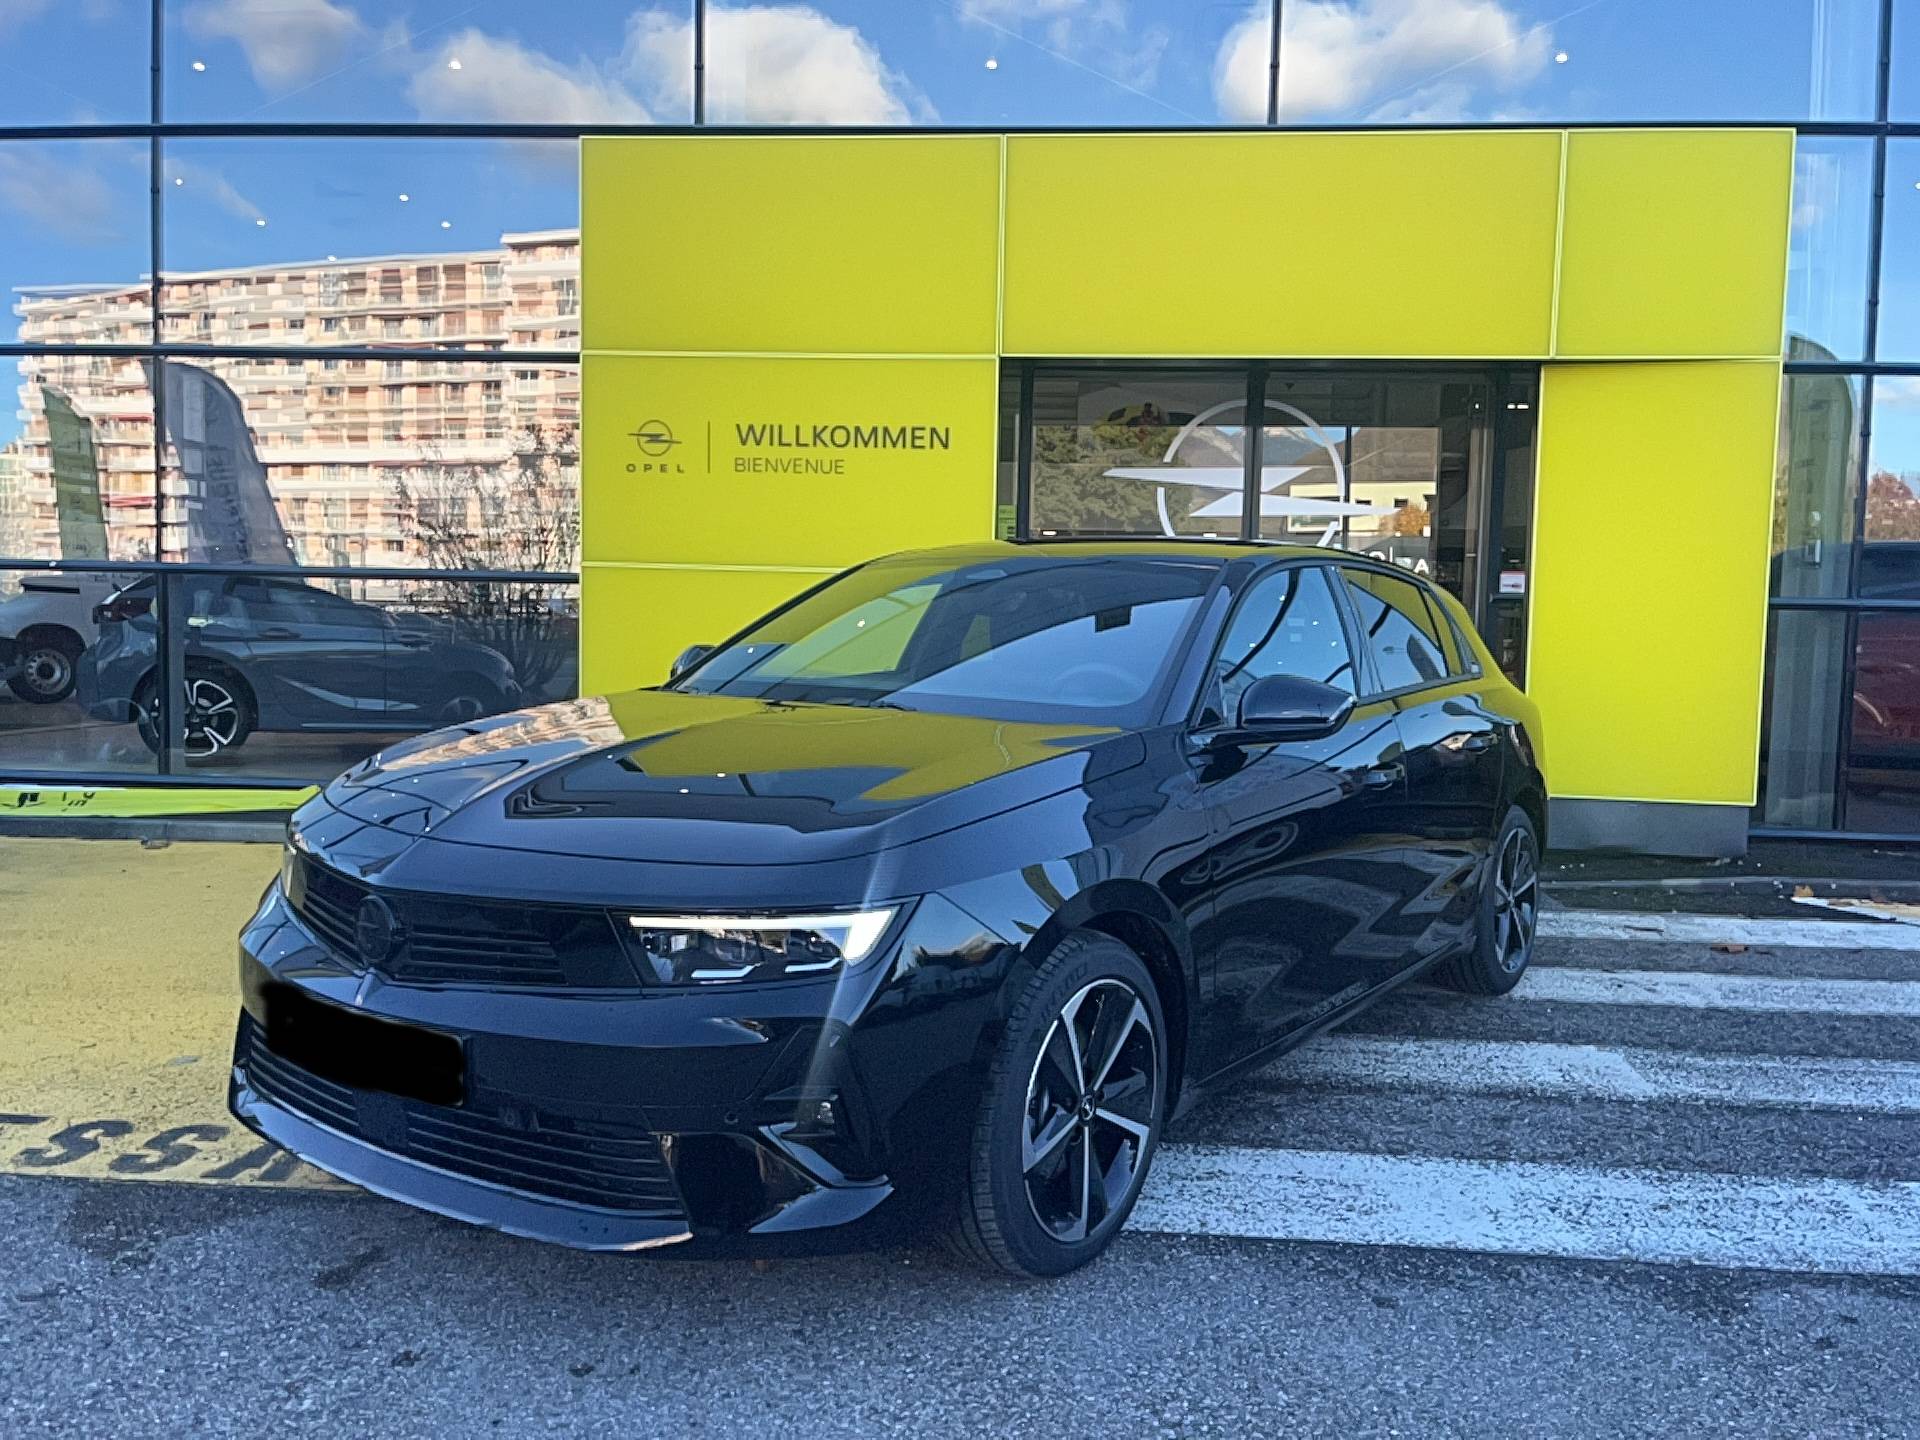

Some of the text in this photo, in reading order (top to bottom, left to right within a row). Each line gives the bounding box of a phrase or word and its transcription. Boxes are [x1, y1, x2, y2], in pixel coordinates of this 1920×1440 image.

[735, 423, 950, 450] WILLKOMMEN
[625, 463, 685, 474] OPEL
[734, 457, 845, 475] BIENVENUE
